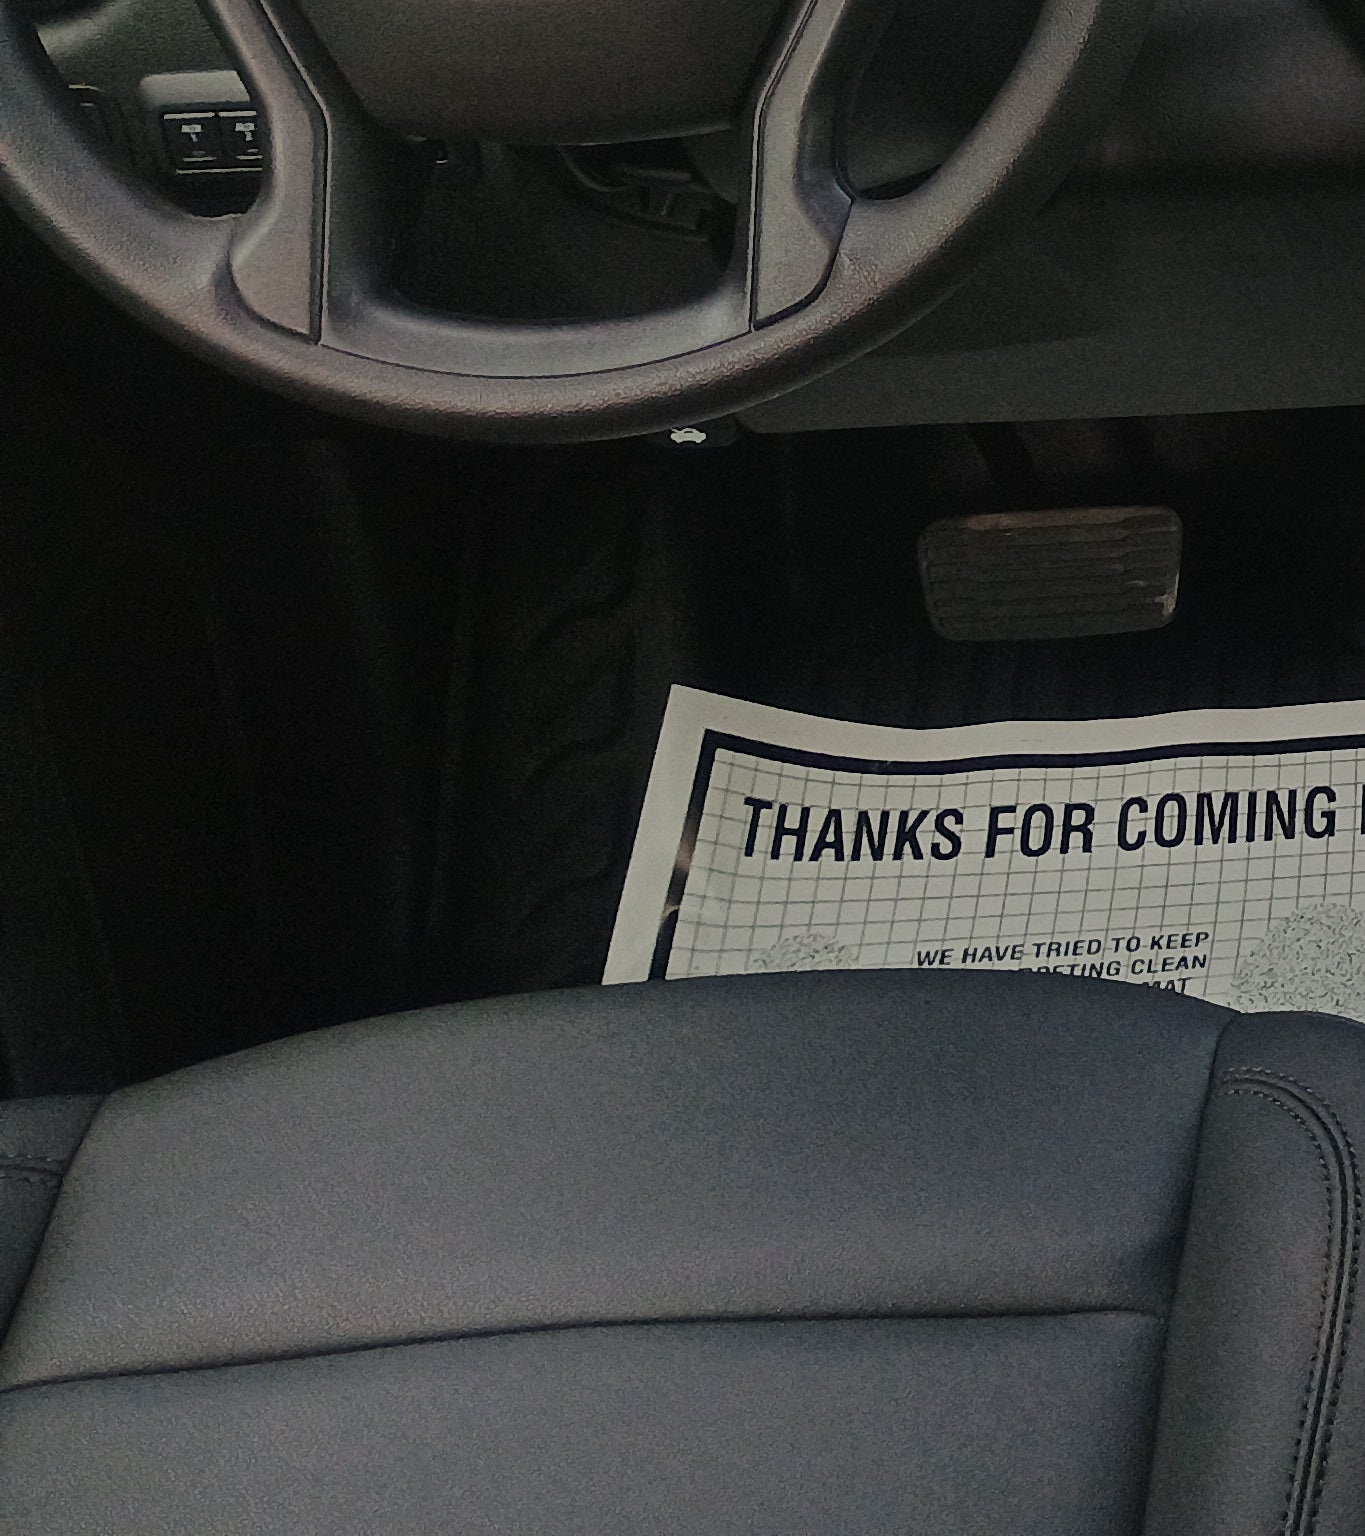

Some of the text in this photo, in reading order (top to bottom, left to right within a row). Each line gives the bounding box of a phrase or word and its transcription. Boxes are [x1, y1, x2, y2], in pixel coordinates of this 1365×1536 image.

[744, 796, 964, 862] THANKS
[984, 802, 1096, 859] FOR
[1117, 785, 1337, 852] COMING
[917, 931, 1210, 967] WE HAVE TRIED TO KEEP
[1131, 954, 1207, 976] CLEAN
